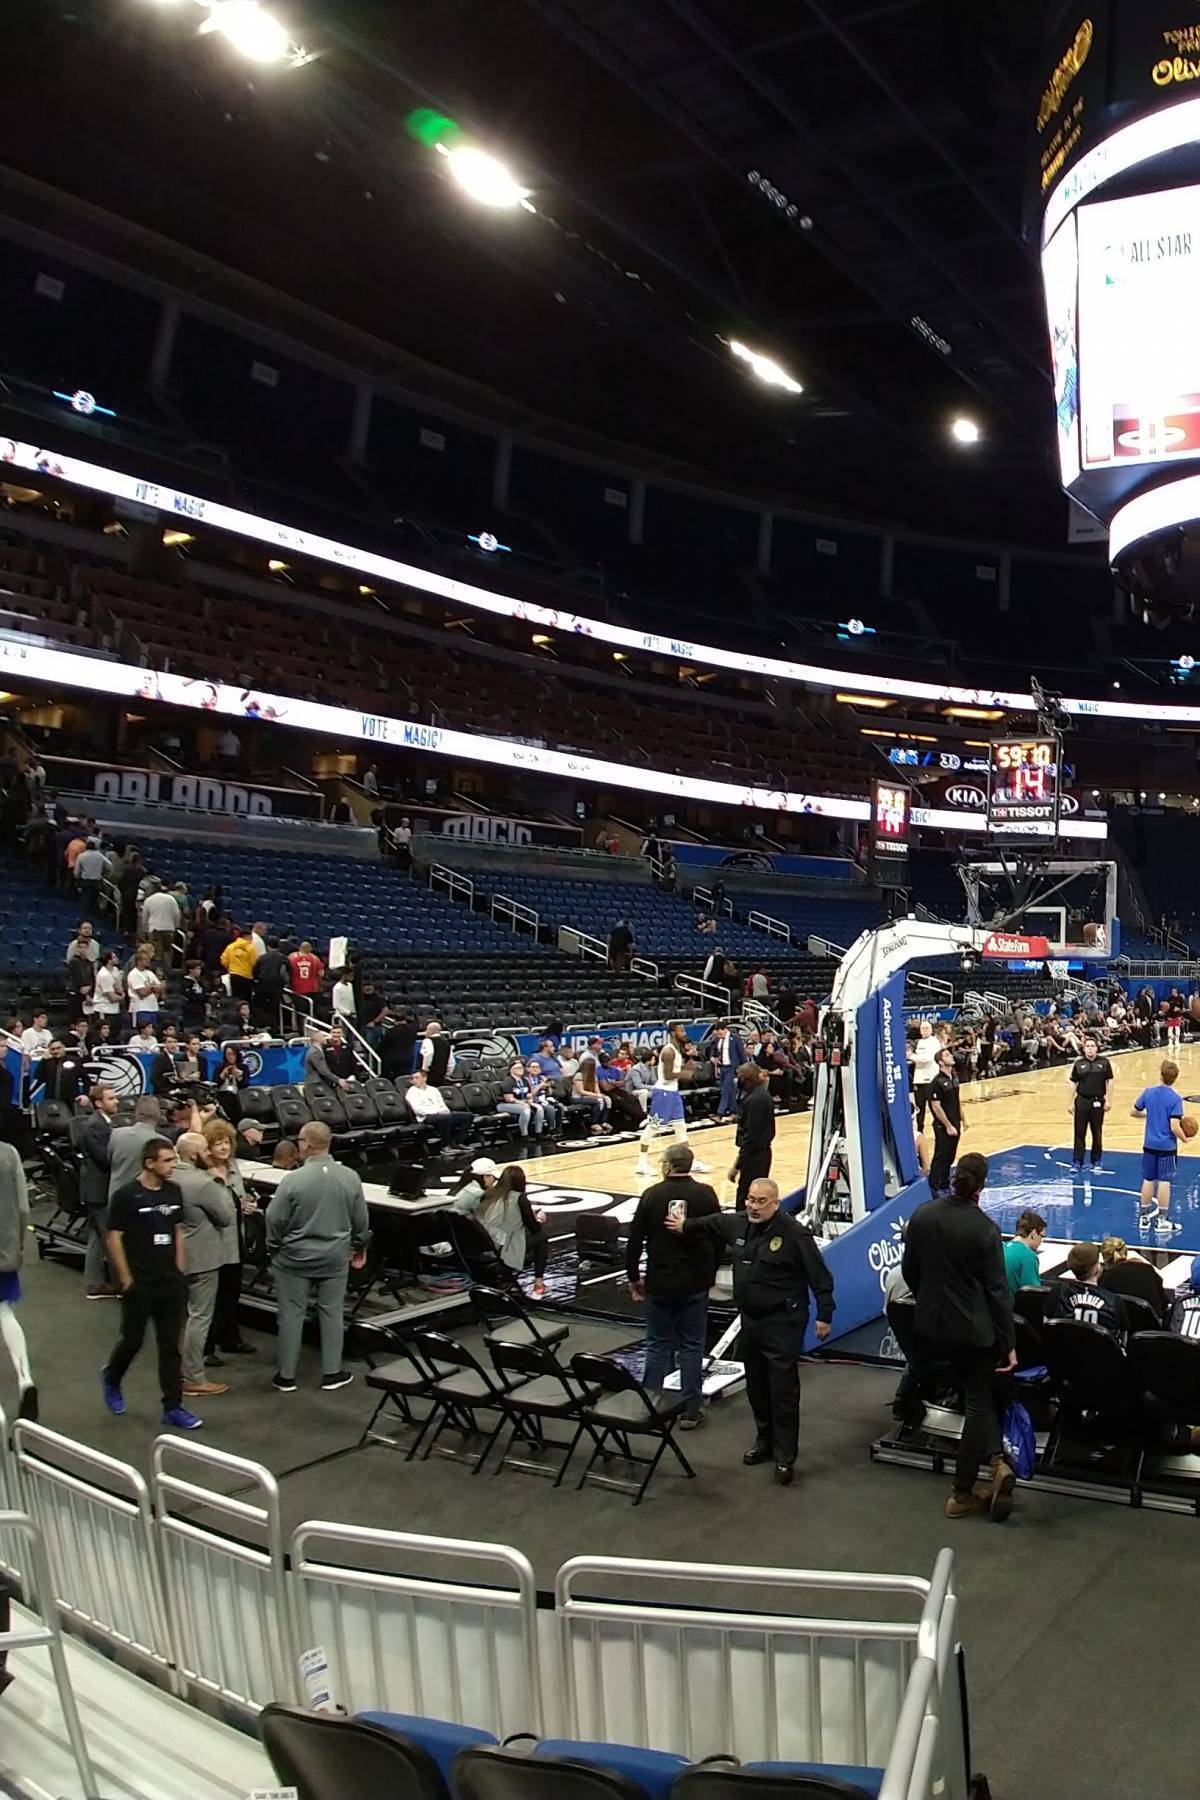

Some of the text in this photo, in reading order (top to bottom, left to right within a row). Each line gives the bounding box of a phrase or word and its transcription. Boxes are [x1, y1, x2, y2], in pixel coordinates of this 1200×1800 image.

[361, 715, 388, 740] VOTE
[1015, 768, 1044, 801] 14
[952, 788, 980, 804] KIA
[1008, 806, 1052, 817] TISSOT
[621, 1030, 670, 1050] MAGI
[868, 1239, 905, 1271] Oliv
